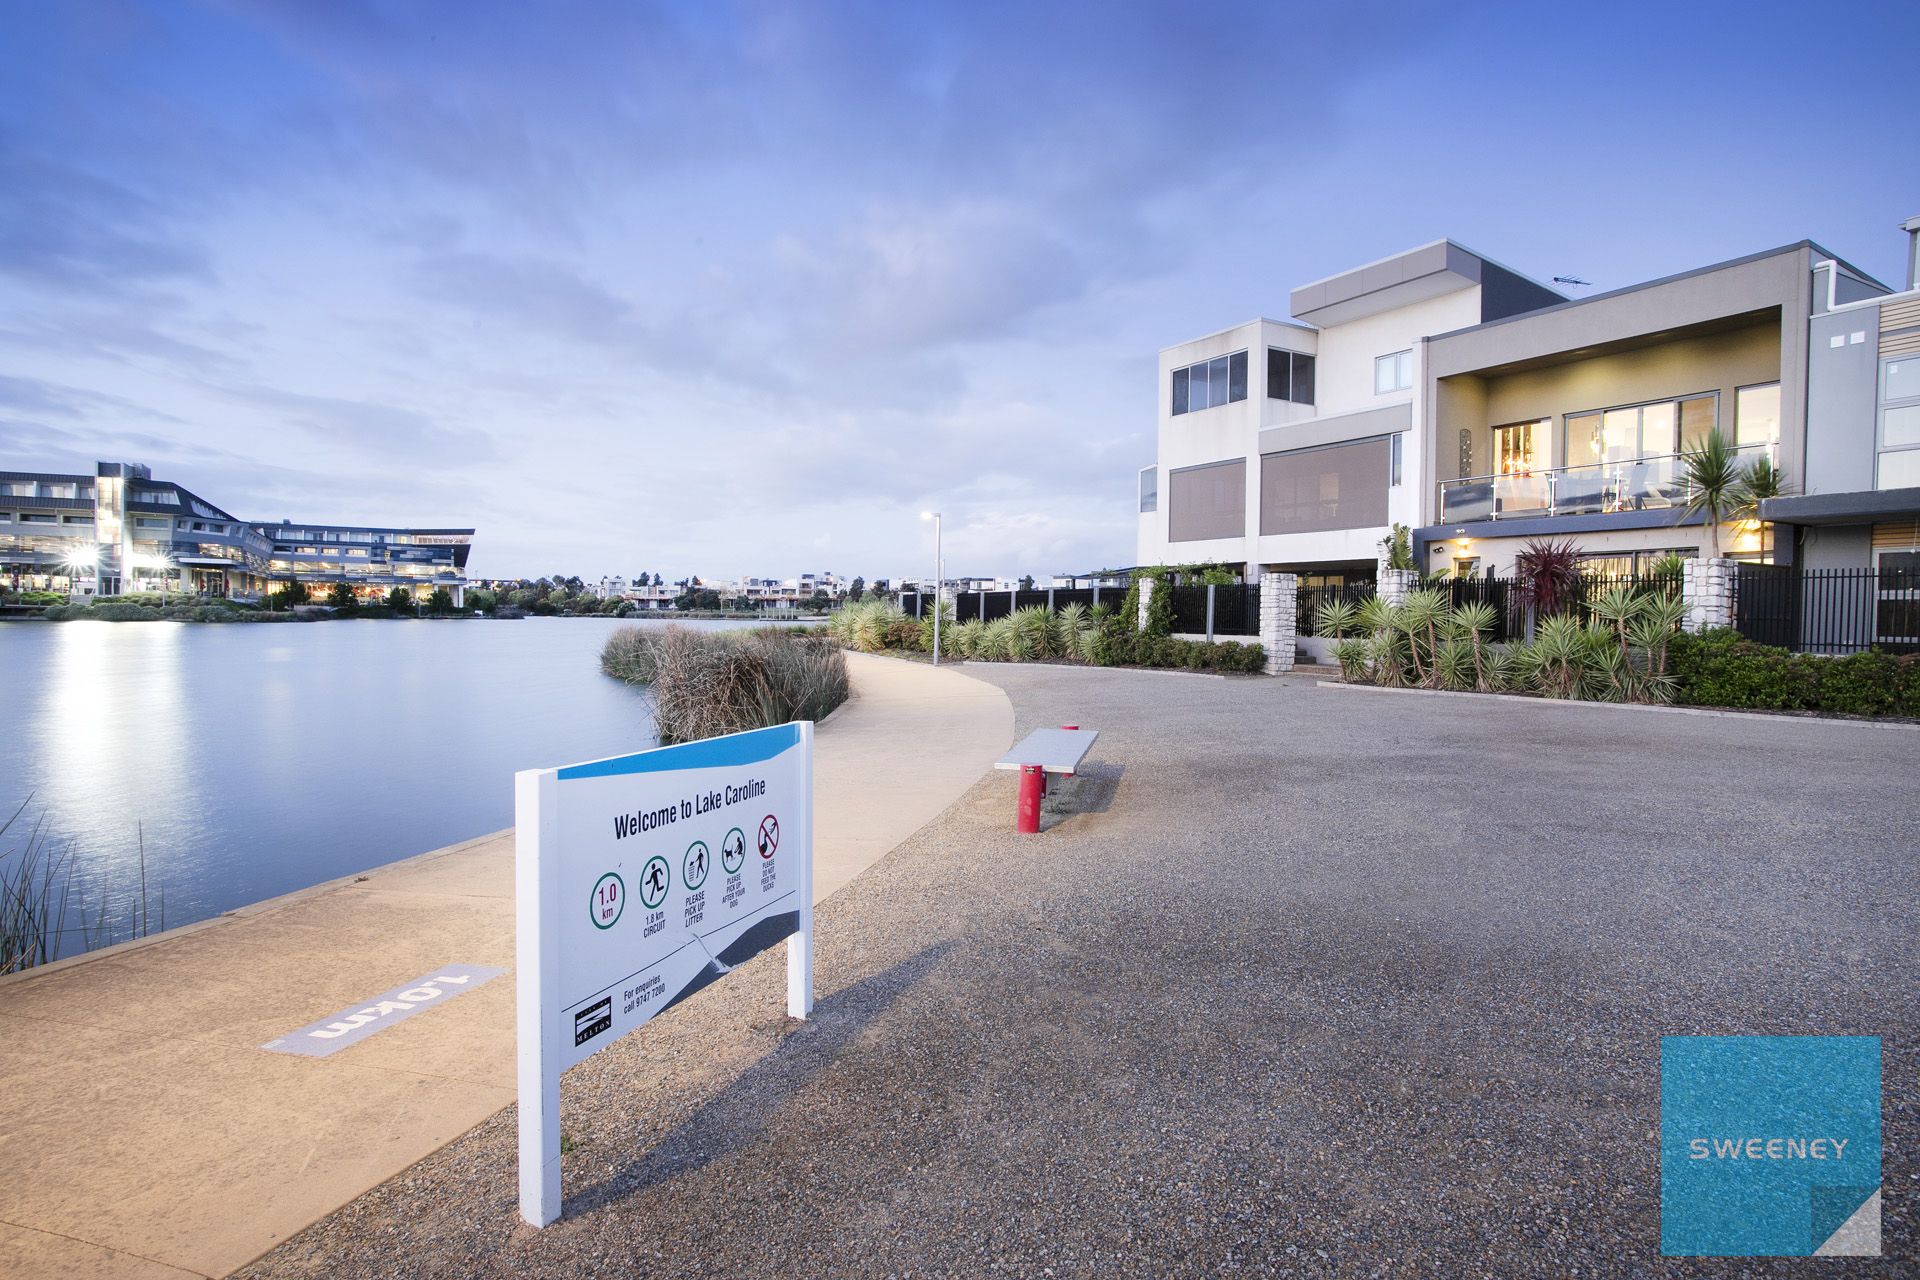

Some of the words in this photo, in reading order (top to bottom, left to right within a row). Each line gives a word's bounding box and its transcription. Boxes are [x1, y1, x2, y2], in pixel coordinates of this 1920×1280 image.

[615, 805, 677, 840] Welcome
[681, 799, 692, 820] to
[696, 790, 722, 815] Lake
[726, 778, 766, 806] Caroline
[762, 858, 775, 869] PLEASE
[727, 873, 741, 885] PLEASE
[761, 877, 769, 885] FEED
[762, 869, 767, 877] DO
[599, 883, 617, 905] 1.0
[726, 884, 735, 893] PICK
[736, 881, 741, 889] UP
[763, 881, 774, 892] DUCKS
[685, 891, 705, 907] PLEASE
[722, 892, 734, 904] AFTER
[735, 887, 745, 898] YOUR
[730, 899, 738, 908] DOG
[602, 907, 614, 920] km
[684, 904, 697, 918] PICK
[697, 901, 706, 913] UP
[645, 914, 655, 925] 1.8
[655, 911, 664, 923] km
[685, 912, 704, 928] LITTER
[643, 920, 666, 938] CIRCUIT
[624, 989, 634, 1001] For
[635, 975, 661, 994] enquiries
[624, 1001, 635, 1014] call
[635, 991, 650, 1007] 9747
[651, 983, 665, 998] 7200
[576, 1020, 611, 1043] MELTON
